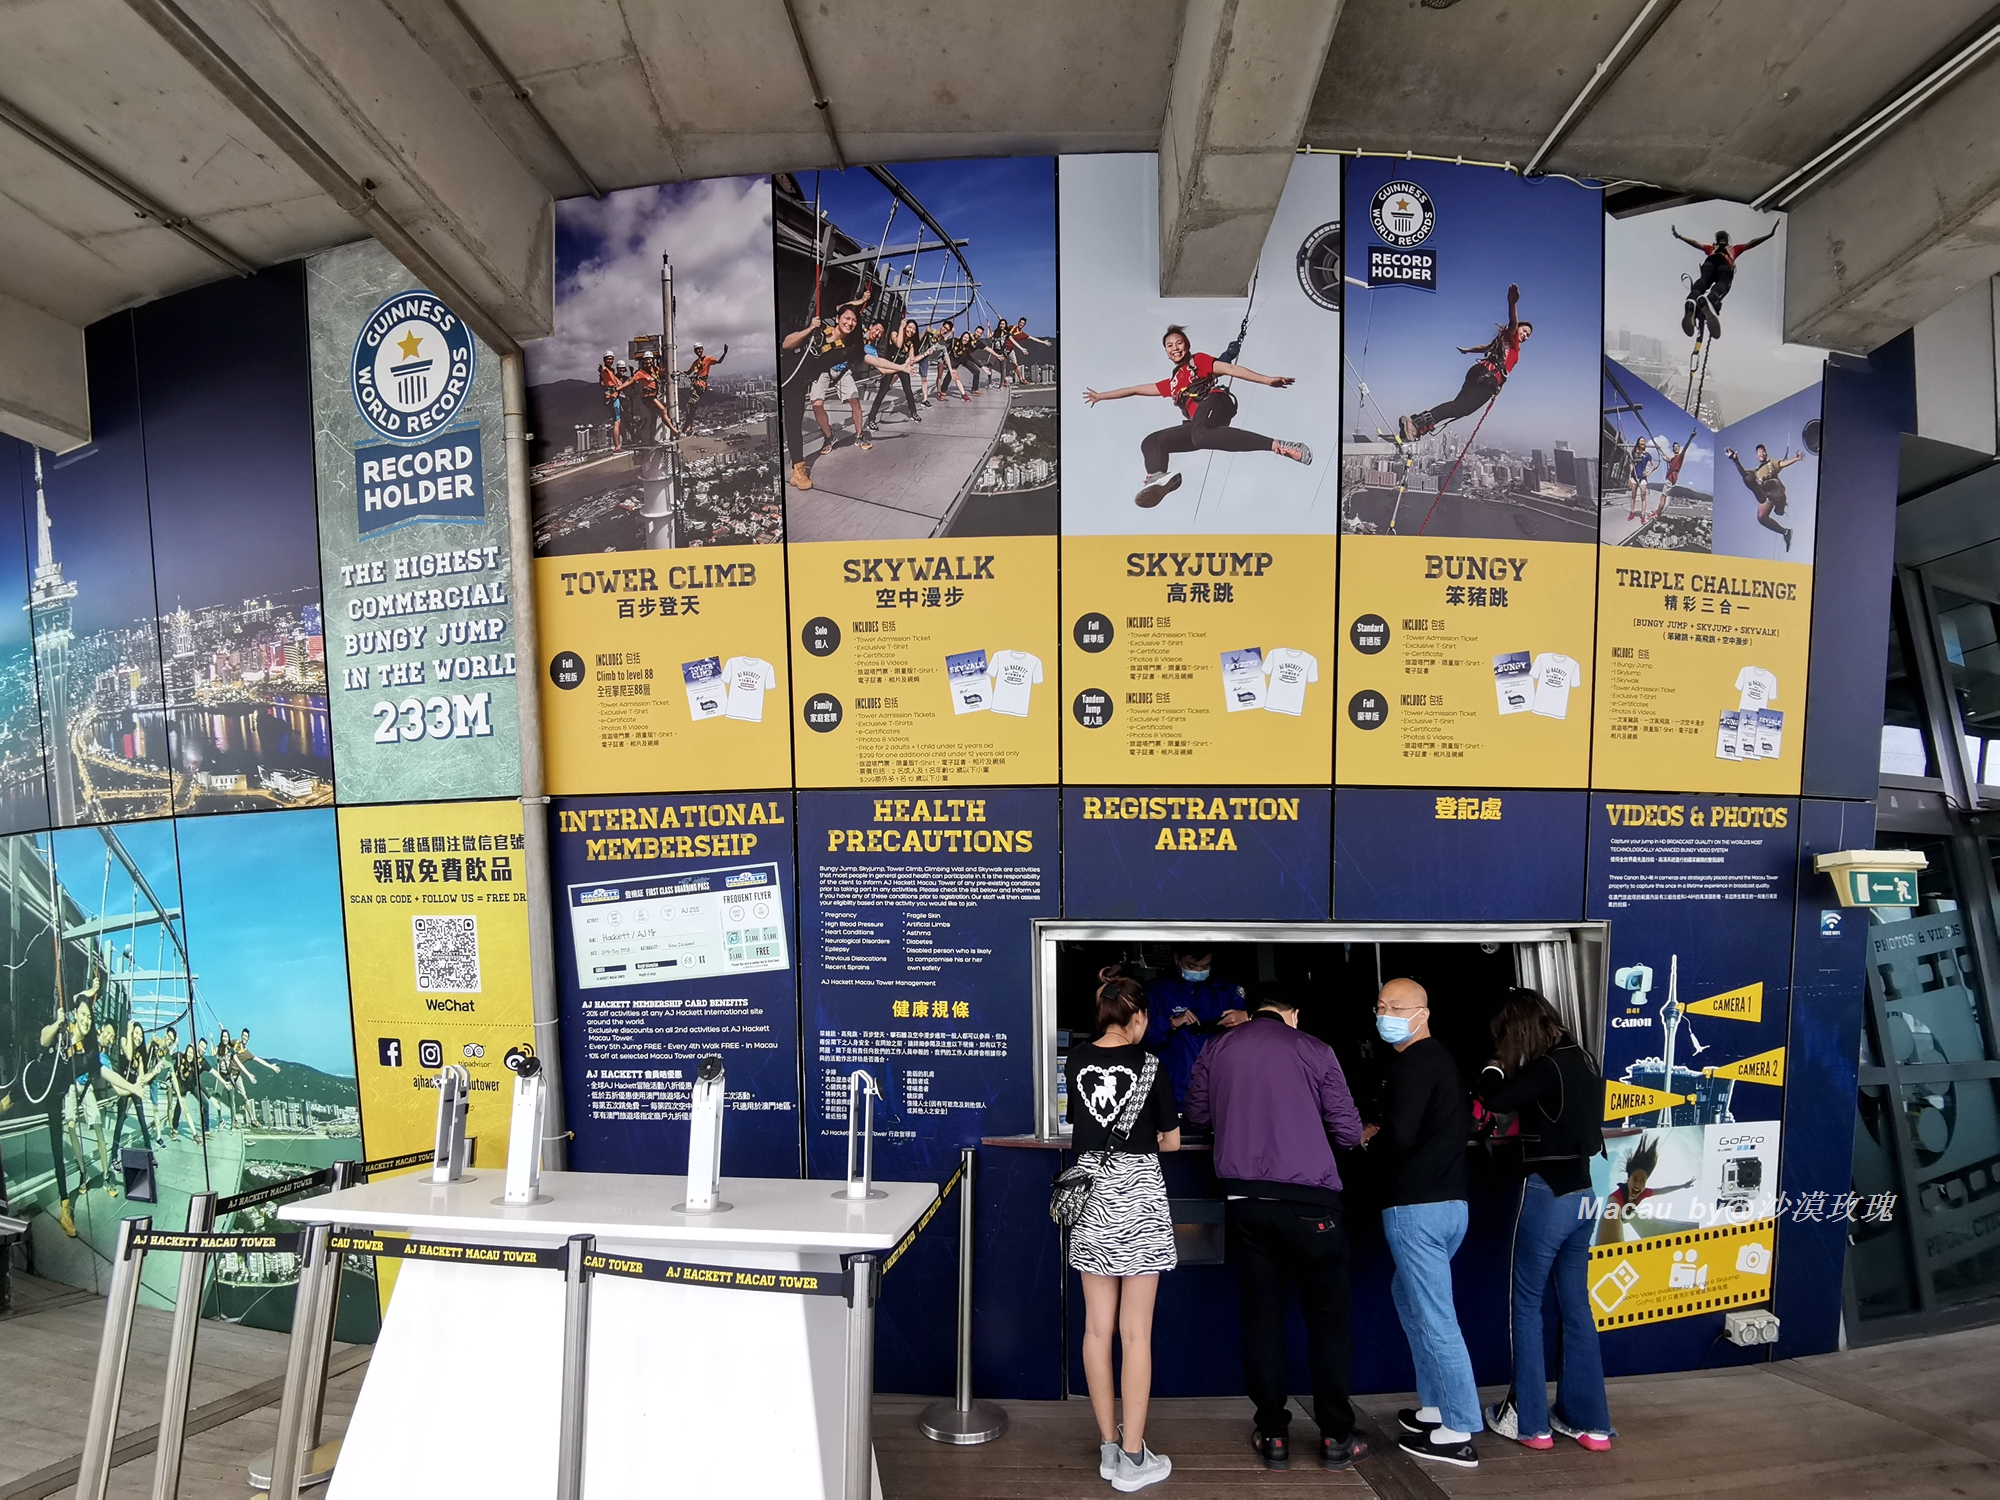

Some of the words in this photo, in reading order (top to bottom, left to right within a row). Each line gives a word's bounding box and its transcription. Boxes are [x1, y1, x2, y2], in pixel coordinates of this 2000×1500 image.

[1378, 184, 1427, 204] GUINNESS
[1373, 208, 1395, 242] WORLD
[1399, 211, 1433, 245] RECORDS
[1372, 253, 1432, 267] RECORD
[1372, 266, 1431, 280] HOLDER
[366, 299, 456, 347] GUINNESS
[357, 366, 401, 432] WORLD
[407, 345, 468, 434] RECORDS
[363, 446, 473, 485] RECORD
[364, 472, 474, 512] HOLDER
[341, 561, 386, 588] THE
[394, 546, 500, 583] HIGHEST
[843, 555, 995, 583] SKYWALK
[1126, 552, 1273, 577] SKYJUMP
[1425, 554, 1528, 581] BUNGY
[561, 568, 658, 595] TOWER
[669, 562, 756, 589] CLIMB
[1616, 568, 1684, 590] TRIPLE
[1691, 574, 1796, 601] CHALLENGE
[348, 582, 507, 620] COMMERCIAL
[876, 586, 965, 609] 空中漫步
[1167, 582, 1234, 603] 高飛跳
[1446, 585, 1508, 607] 笨豬跳
[617, 595, 700, 619] 百步登天
[1664, 594, 1750, 615] 精彩三合一
[814, 626, 828, 636] Solo
[853, 621, 879, 633] INCLUDES
[882, 621, 896, 632] 包括
[1088, 621, 1099, 630] Full
[1127, 617, 1153, 629] INCLUDES
[1156, 616, 1171, 628] 包括
[1357, 623, 1383, 633] Standard
[1402, 619, 1428, 630] INCLUDES
[1431, 620, 1445, 631] 包括
[1667, 621, 1688, 629] JUMP
[1697, 623, 1732, 632] SKYJUMP
[345, 626, 427, 656] BUNGY
[436, 618, 506, 647] JUMP
[815, 639, 829, 649] 個人
[596, 653, 622, 666] INCLUDES
[626, 652, 640, 664] 包括
[1612, 647, 1633, 658] INCLUDES
[342, 665, 369, 691] IN
[378, 664, 425, 687] THE
[432, 653, 517, 682] WORLD
[563, 659, 573, 668] Full
[597, 671, 616, 681] Climb
[618, 671, 625, 680] to
[627, 669, 642, 680] level
[645, 669, 653, 679] 88
[814, 700, 833, 711] Family
[855, 698, 881, 709] INCLUDES
[884, 697, 898, 708] 包括
[1082, 694, 1105, 704] Tandem
[1126, 692, 1153, 704] INCLUDES
[1156, 692, 1170, 703] 包括
[1363, 699, 1374, 708] Full
[1400, 694, 1426, 706] INCLUDES
[1429, 695, 1443, 706] 包括
[373, 693, 493, 744] 233M
[810, 713, 837, 723] 家庭套票
[1085, 705, 1101, 715] Jump
[874, 799, 986, 822] HEALTH
[1083, 797, 1299, 821] REGISTRATION
[1435, 797, 1502, 820] 登記處
[1606, 804, 1684, 826] VIDEOS
[1690, 806, 1704, 826] &
[1710, 806, 1788, 828] PHOTOS
[559, 802, 784, 833] INTERNATIONAL
[586, 833, 757, 861] MEMBERSHIP
[828, 830, 1033, 853] PRECAUTIONS
[1155, 827, 1237, 851] AREA
[373, 856, 512, 884] 領取免費飲品
[350, 895, 373, 904] SCAN
[376, 895, 387, 904] QR
[390, 895, 412, 904] CODE
[423, 894, 457, 903] FOLLOW
[461, 894, 474, 902] US
[487, 893, 510, 902] FREE
[513, 893, 527, 902] DR
[646, 888, 659, 897] FIRST
[660, 886, 674, 895] CLASS
[723, 894, 752, 904] FREQUENT
[754, 891, 771, 900] FLYER
[1874, 934, 1915, 952] PHOTOS
[1918, 932, 1925, 943] &
[756, 946, 770, 956] FREE
[426, 999, 475, 1012] WeChat
[633, 1000, 683, 1008] MEMBERSHIP
[710, 999, 748, 1007] BENEFITS
[892, 1000, 970, 1019] 健康規條
[1713, 998, 1745, 1012] CAMERA
[1747, 996, 1751, 1012] 1
[1611, 1017, 1652, 1028] Canon
[586, 1070, 598, 1079] AJ
[601, 1070, 643, 1079] HACKETT
[1738, 1061, 1771, 1076] CAMERA
[1773, 1060, 1778, 1077] 2
[1611, 1094, 1646, 1111] CAMERA
[1649, 1095, 1654, 1105] 3
[1719, 1135, 1765, 1146] GoPro
[365, 1160, 394, 1172] HACKETT
[395, 1156, 416, 1168] MACAU
[228, 1200, 238, 1208] AJ
[239, 1192, 268, 1206] HACKETT
[270, 1185, 292, 1198] MACAU
[293, 1178, 313, 1189] TOWER
[134, 1235, 148, 1244] AJ
[150, 1236, 198, 1247] HACKETT
[200, 1238, 238, 1247] MACAU
[241, 1238, 276, 1247] TOWER
[331, 1238, 351, 1248] CAU
[353, 1240, 383, 1250] TOWER
[404, 1244, 416, 1253] AJ
[419, 1245, 463, 1258] HACKETT
[465, 1249, 500, 1261] MACAU
[503, 1251, 537, 1262] TOWER
[608, 1259, 643, 1273] TOWER
[666, 1266, 681, 1278] AJ
[683, 1268, 733, 1283] HACKETT
[736, 1273, 775, 1286] MACAU
[779, 1276, 818, 1289] TOWER
